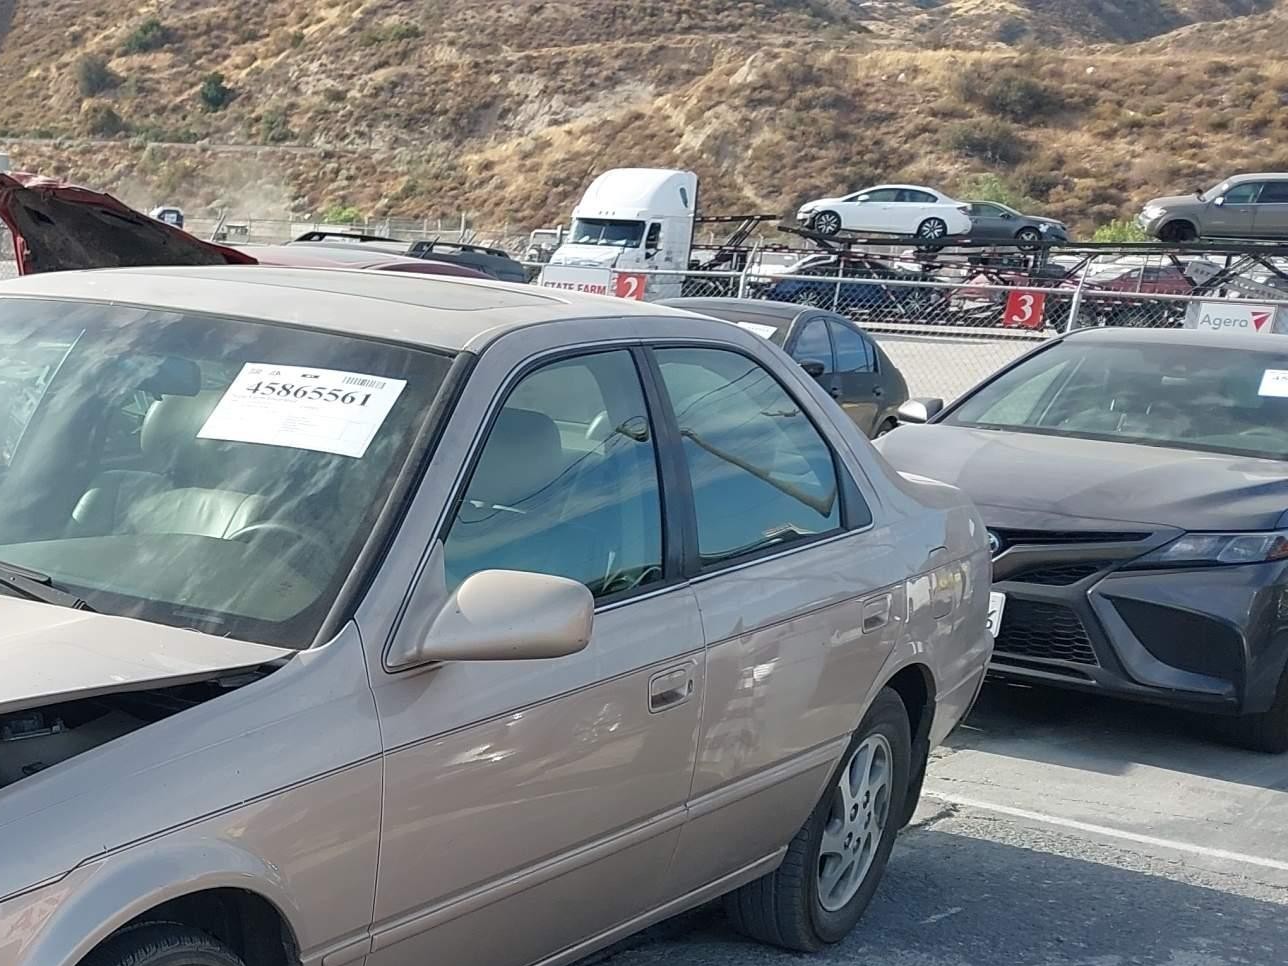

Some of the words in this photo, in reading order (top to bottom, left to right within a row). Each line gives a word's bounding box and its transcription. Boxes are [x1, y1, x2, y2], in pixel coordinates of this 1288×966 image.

[577, 284, 606, 295] FARM
[623, 276, 638, 299] 2
[1011, 294, 1034, 322] 3
[1199, 313, 1249, 330] Agero
[245, 381, 373, 407] 45865561
